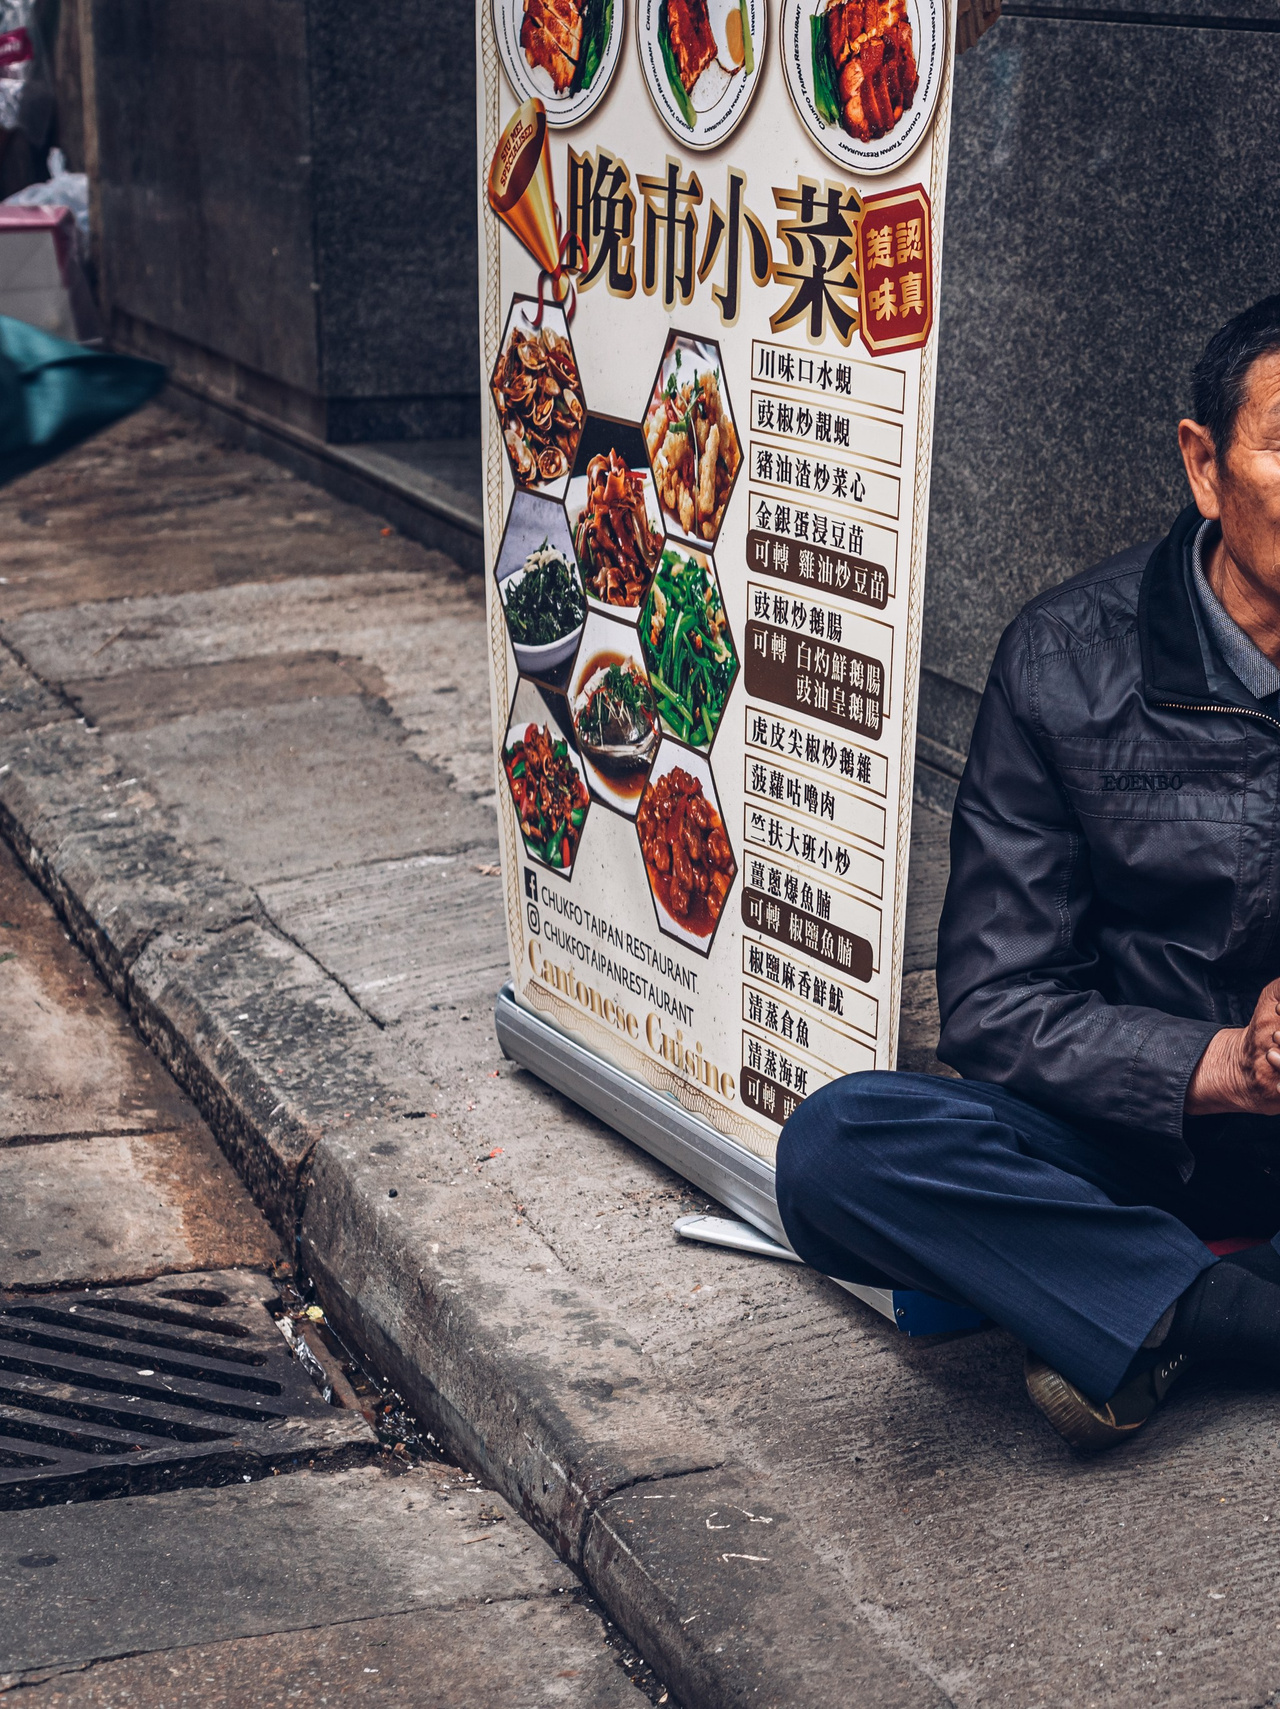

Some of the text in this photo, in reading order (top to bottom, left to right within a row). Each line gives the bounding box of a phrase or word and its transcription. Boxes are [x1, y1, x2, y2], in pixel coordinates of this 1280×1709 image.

[500, 119, 524, 164] SIU MEI
[500, 124, 534, 187] SPECIALISED
[567, 145, 861, 348] 晚市小菜
[866, 217, 925, 321] 認真 惹味
[758, 349, 852, 395] 川味口水蜆
[757, 399, 851, 447] 豉椒炒靚蜆
[756, 450, 867, 502] 豬油渣炒菜心
[755, 500, 864, 556] 金銀蛋浸豆苗
[753, 539, 886, 602] 可轉 雞油炒豆苗
[754, 590, 843, 643] 豉椒炒鵝腸
[752, 627, 881, 697] 可轉 白灼鮮鵝腸
[796, 674, 880, 731] 豉油皇鵝腸
[751, 715, 872, 785] 虎皮尖椒炒鵝雜
[751, 763, 836, 822] 菠蘿咕嚕肉
[541, 885, 584, 926] CHUKFO
[584, 910, 624, 951] TAIPAN
[748, 895, 853, 969] 可轉 椒鹽魚腩
[544, 921, 695, 1028] CHUKFOTAIPANRESTAURANT
[748, 945, 844, 1017] 椒鹽麻香鮮魷
[528, 939, 736, 1101] Cantonese Cuisine
[748, 991, 810, 1049] 清蒸倉魚
[747, 1039, 809, 1097] 清蒸海班
[747, 1073, 777, 1115] 可轉
